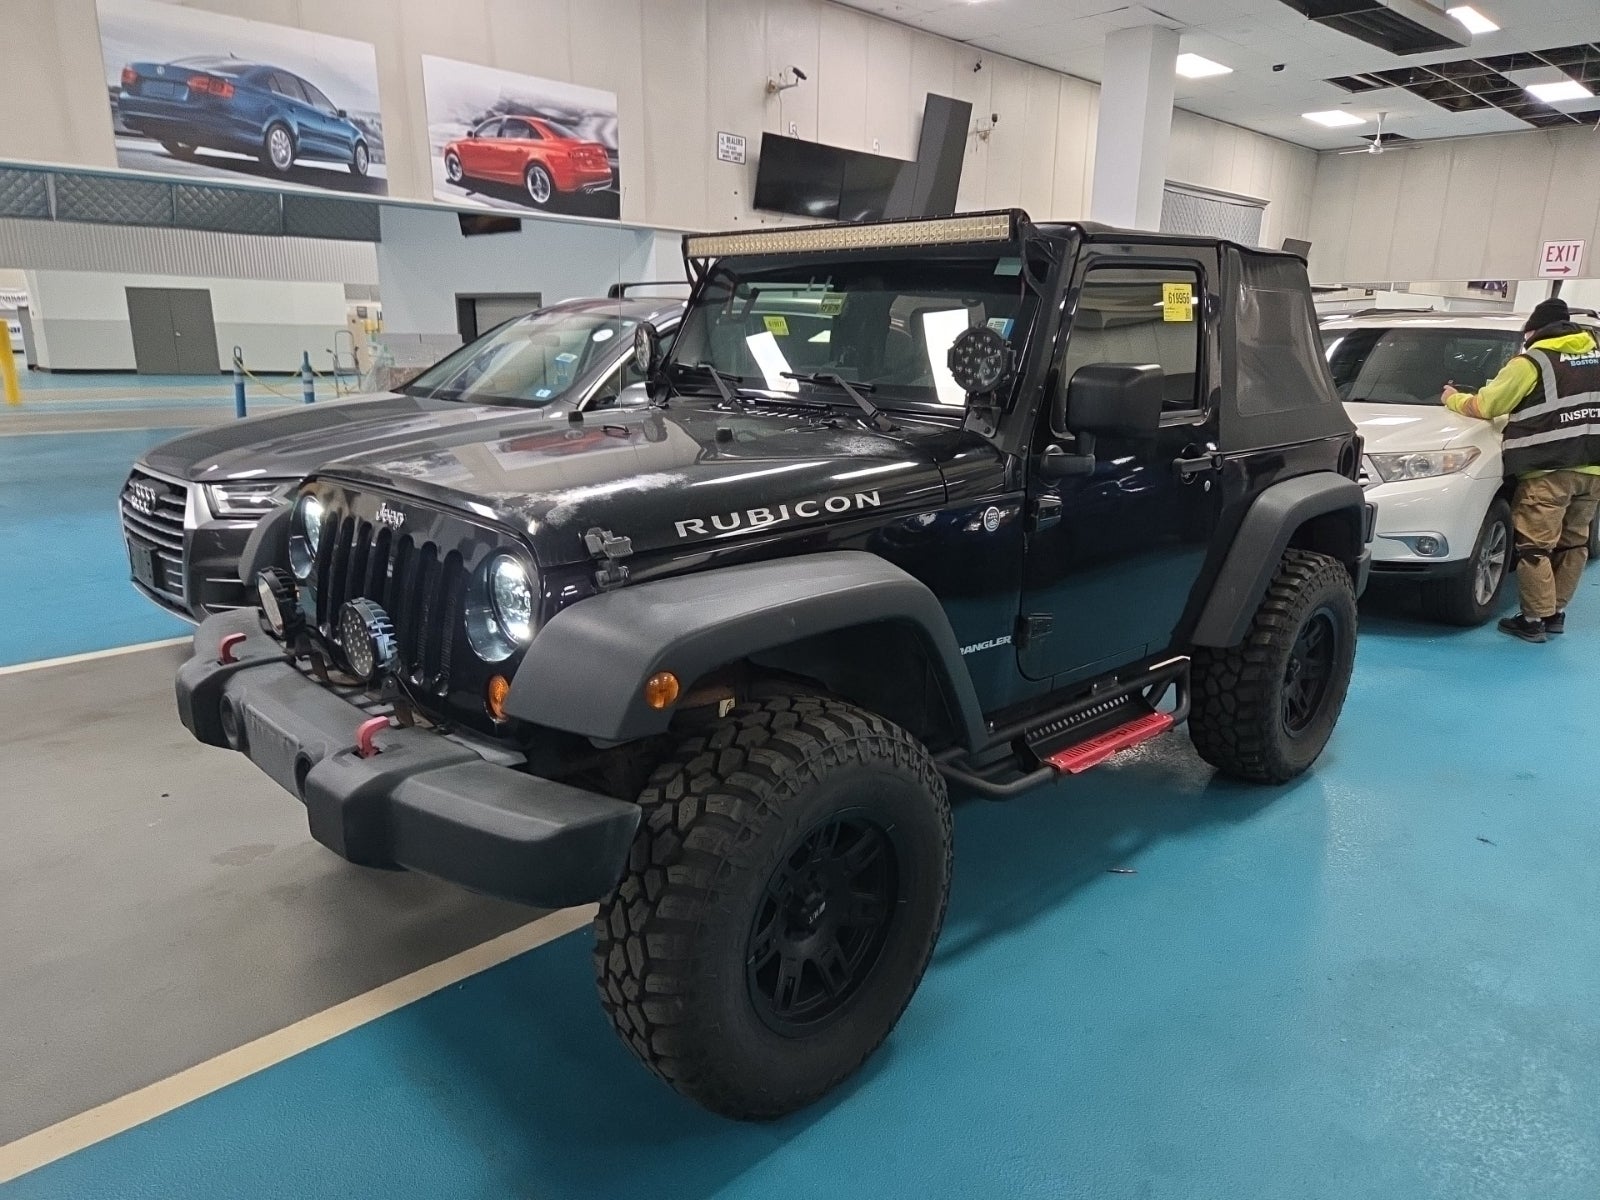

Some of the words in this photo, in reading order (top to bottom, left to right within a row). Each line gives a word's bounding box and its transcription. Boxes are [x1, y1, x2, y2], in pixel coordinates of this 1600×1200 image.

[1545, 245, 1580, 262] EXIT
[1560, 408, 1600, 423] INSPCT
[674, 490, 881, 538] RUBICON
[960, 635, 1012, 656] ANGLER
